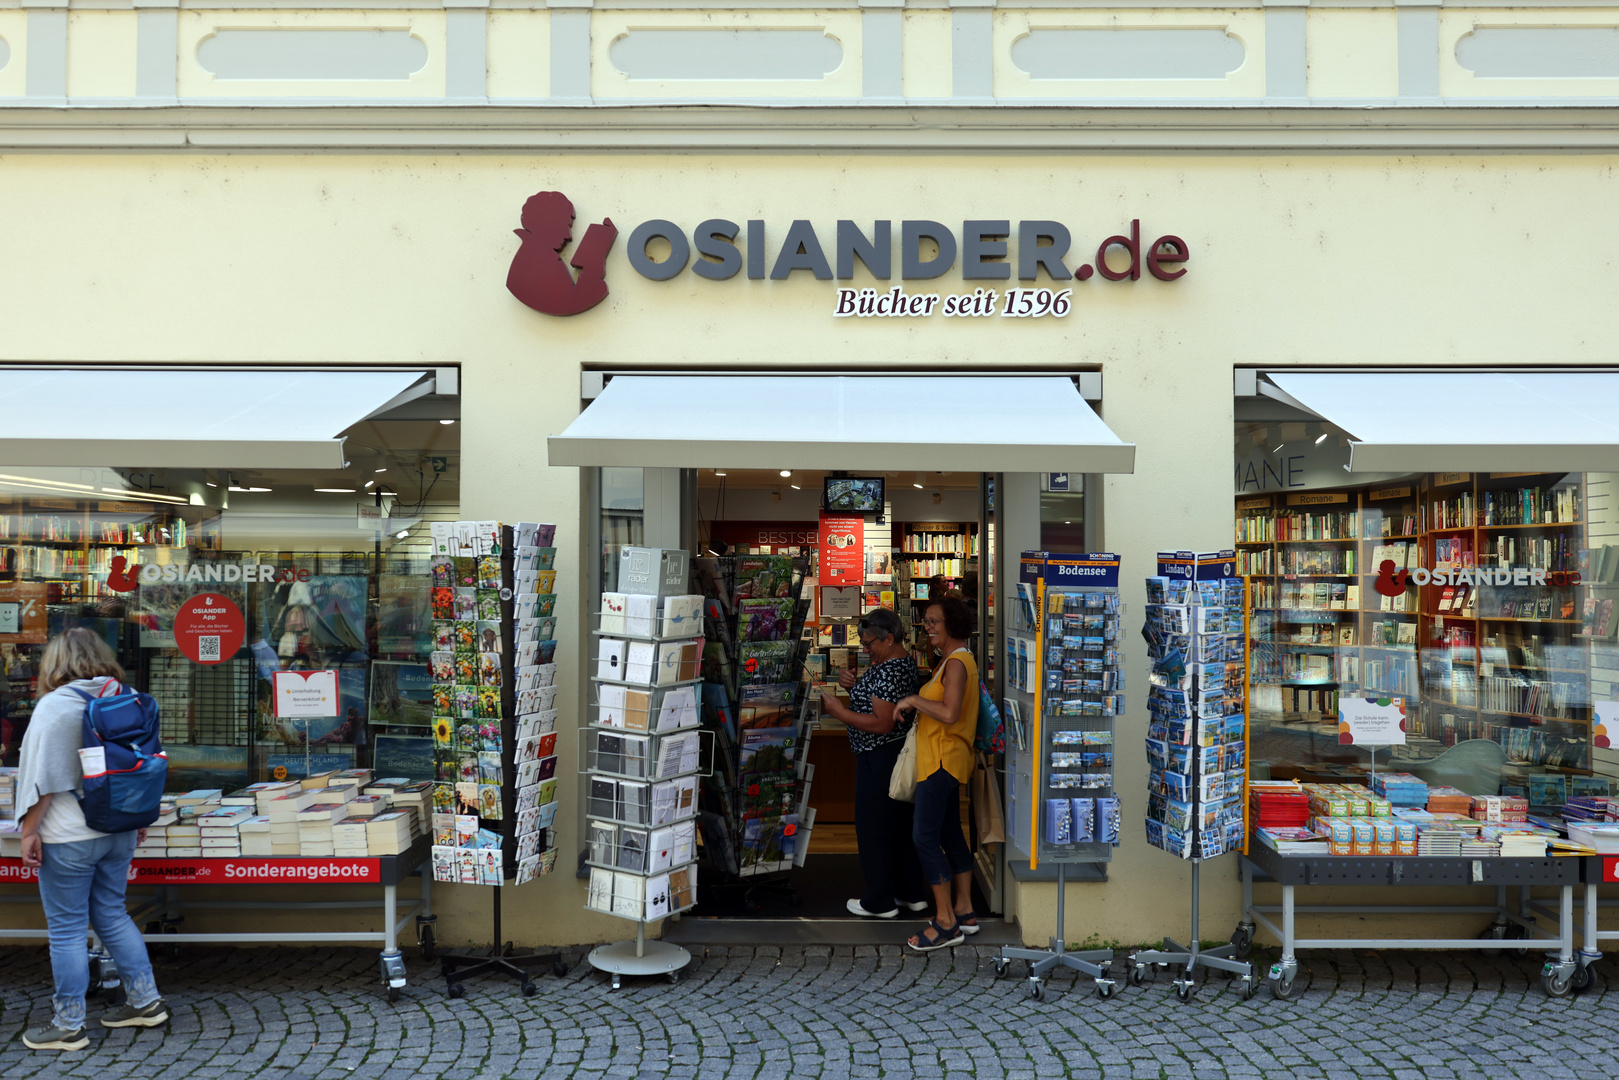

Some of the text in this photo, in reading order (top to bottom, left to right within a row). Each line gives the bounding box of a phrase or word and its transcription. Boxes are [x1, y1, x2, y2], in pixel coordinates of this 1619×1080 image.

[626, 218, 1190, 282] OSIANDER.de
[835, 288, 1071, 317] Bücher seit 1596
[1378, 489, 1401, 498] Romane
[1300, 495, 1334, 503] Romane
[115, 504, 139, 512] Reisen
[142, 563, 310, 583] OSIANDER.de
[1058, 565, 1106, 576] Bodensee
[1411, 567, 1582, 586] OSIANDER.de
[146, 632, 175, 640] ALPE
[405, 674, 433, 683] Boden
[284, 757, 339, 765] DEUTSCHLAND
[138, 867, 212, 876] OSIANDER.de
[224, 863, 370, 880] Sonderangebote
